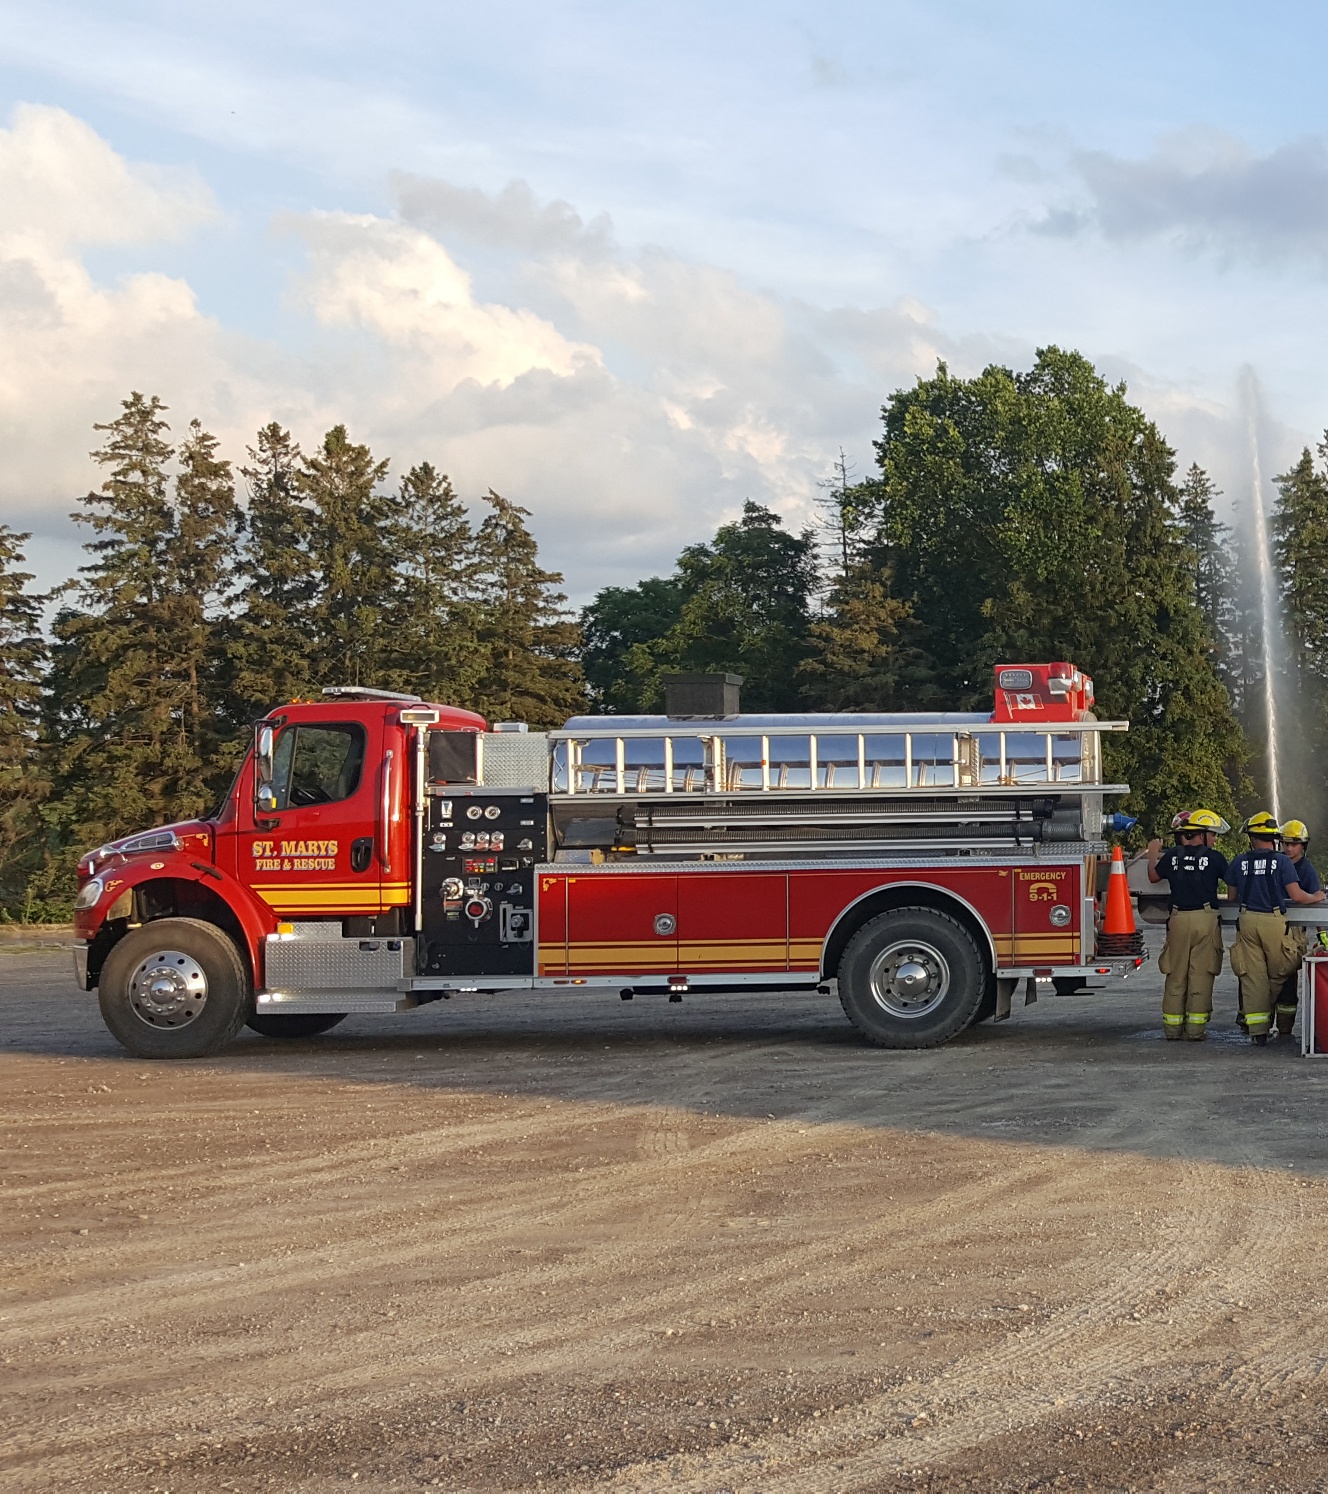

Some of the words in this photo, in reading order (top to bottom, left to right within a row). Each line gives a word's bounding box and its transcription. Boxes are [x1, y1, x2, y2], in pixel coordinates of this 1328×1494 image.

[280, 840, 338, 856] MARYS
[256, 859, 280, 870] FIRE
[282, 859, 291, 870] &
[293, 859, 335, 870] RESCUE
[1020, 871, 1066, 880] EMERGENCY
[1029, 893, 1057, 902] 9-1-1
